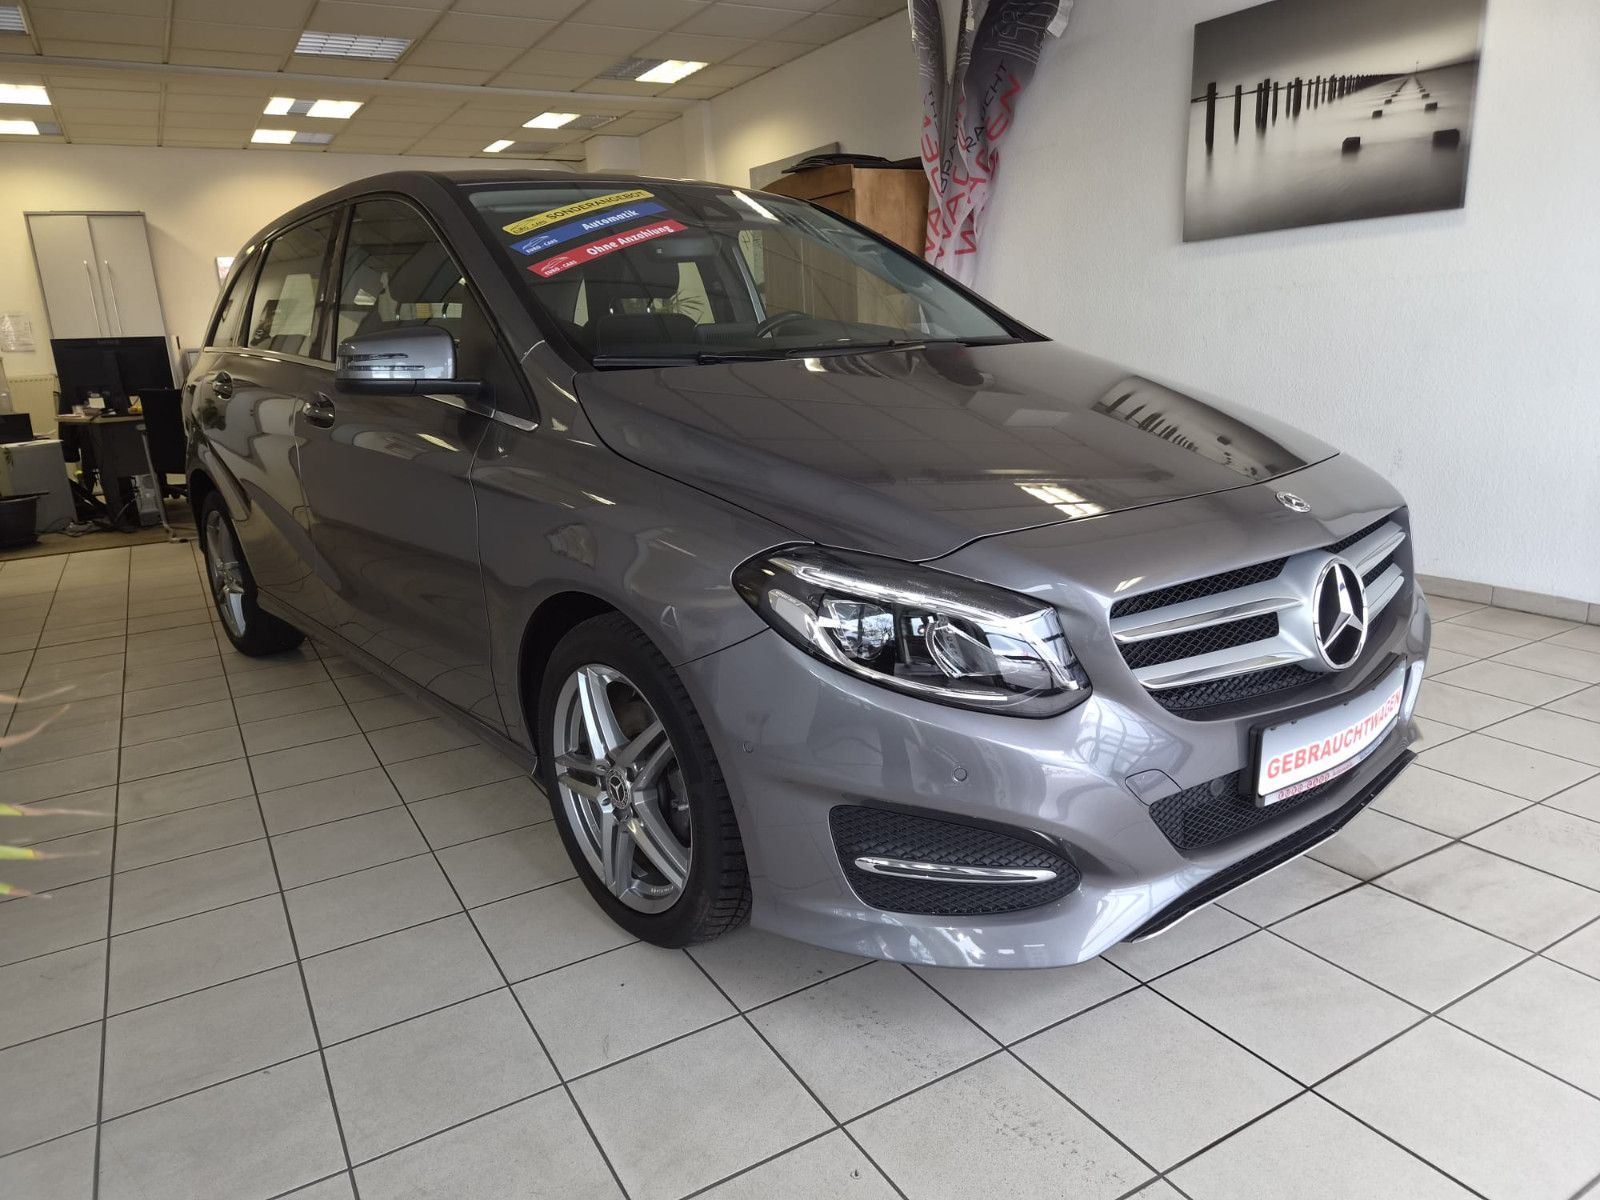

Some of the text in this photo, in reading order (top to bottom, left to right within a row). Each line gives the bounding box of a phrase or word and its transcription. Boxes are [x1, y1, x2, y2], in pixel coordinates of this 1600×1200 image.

[546, 190, 644, 220] SONDERANGEBOT
[582, 209, 639, 231] Automatik
[587, 225, 674, 256] Ohne Anzahlung
[1267, 688, 1402, 780] GEBRAUCHTWAGEN
